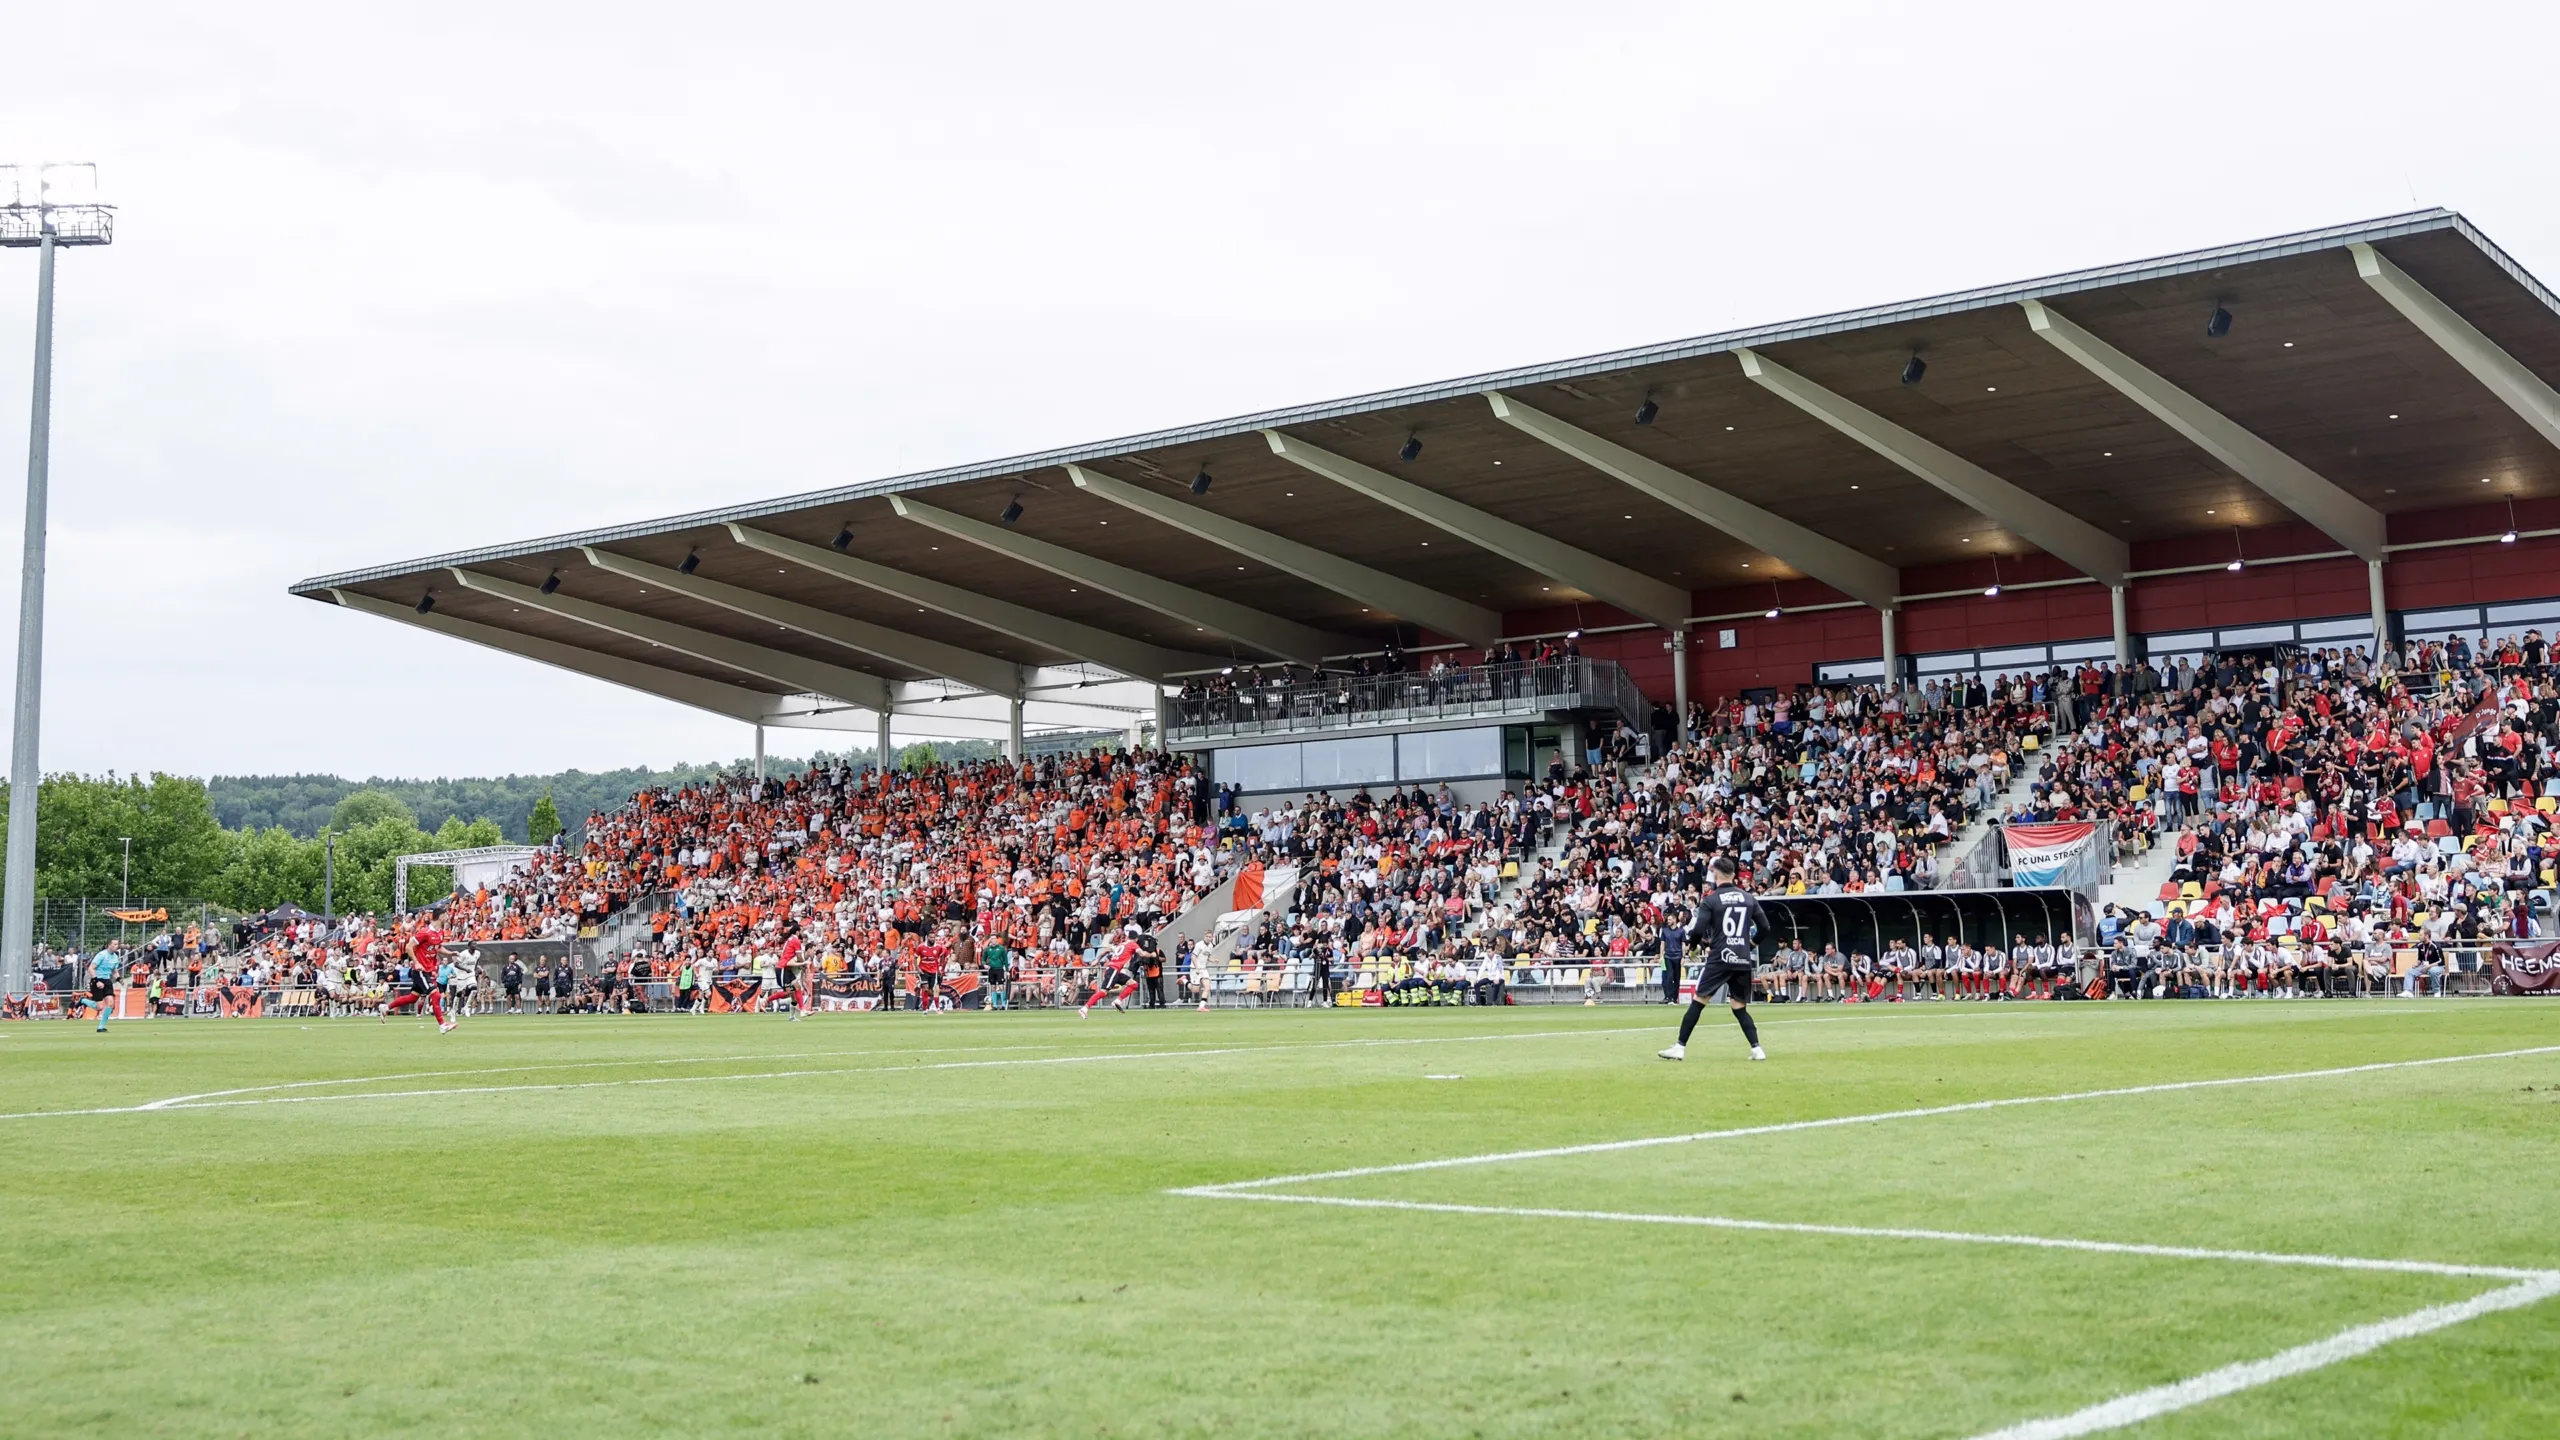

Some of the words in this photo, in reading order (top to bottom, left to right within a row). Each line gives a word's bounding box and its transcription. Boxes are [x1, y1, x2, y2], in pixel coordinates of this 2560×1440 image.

[2018, 857, 2028, 865] FC
[2030, 855, 2051, 864] UNA
[1722, 906, 1748, 937] 67
